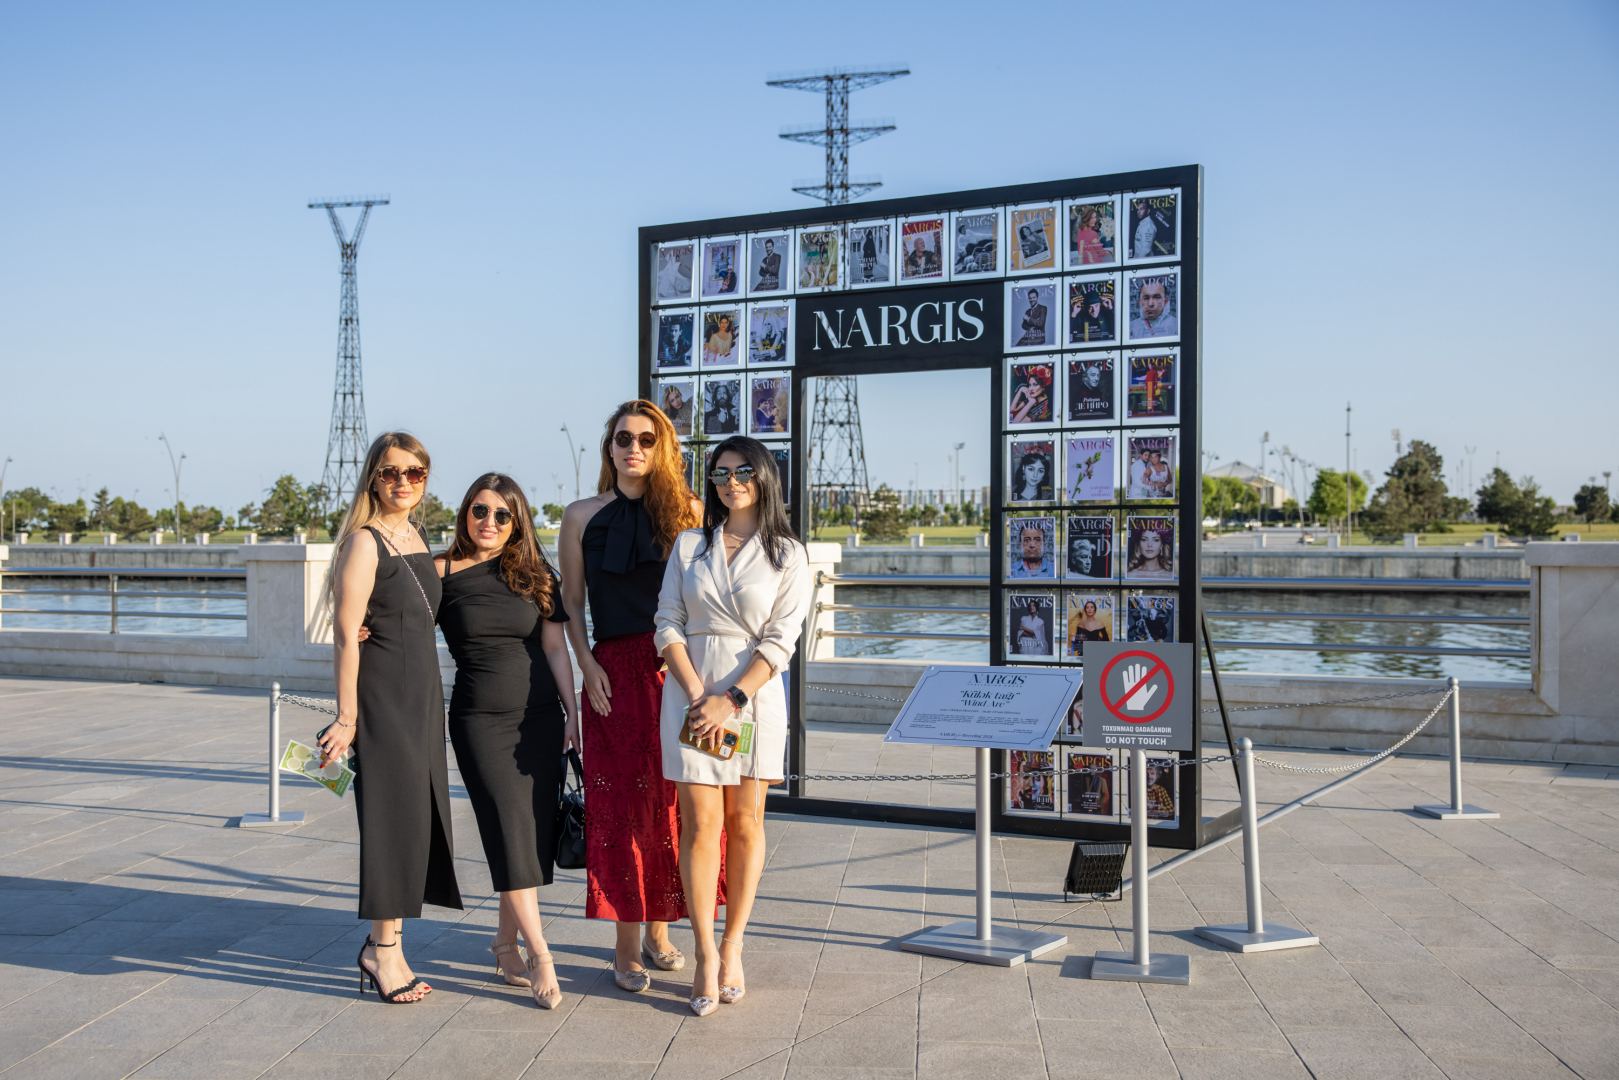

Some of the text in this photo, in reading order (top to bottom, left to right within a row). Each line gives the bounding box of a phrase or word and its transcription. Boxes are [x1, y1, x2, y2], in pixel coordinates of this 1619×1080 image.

[1131, 195, 1176, 211] NRGIS
[903, 220, 942, 234] NARGIS
[1071, 281, 1114, 297] NARGIS
[813, 298, 984, 350] NARGIS
[1070, 438, 1112, 451] NARGIS
[1070, 517, 1112, 530] NARGIS
[1131, 518, 1174, 530] NARGIS
[968, 673, 1026, 686] NARGIS
[1105, 736, 1167, 746] DO NOT TOUCH
